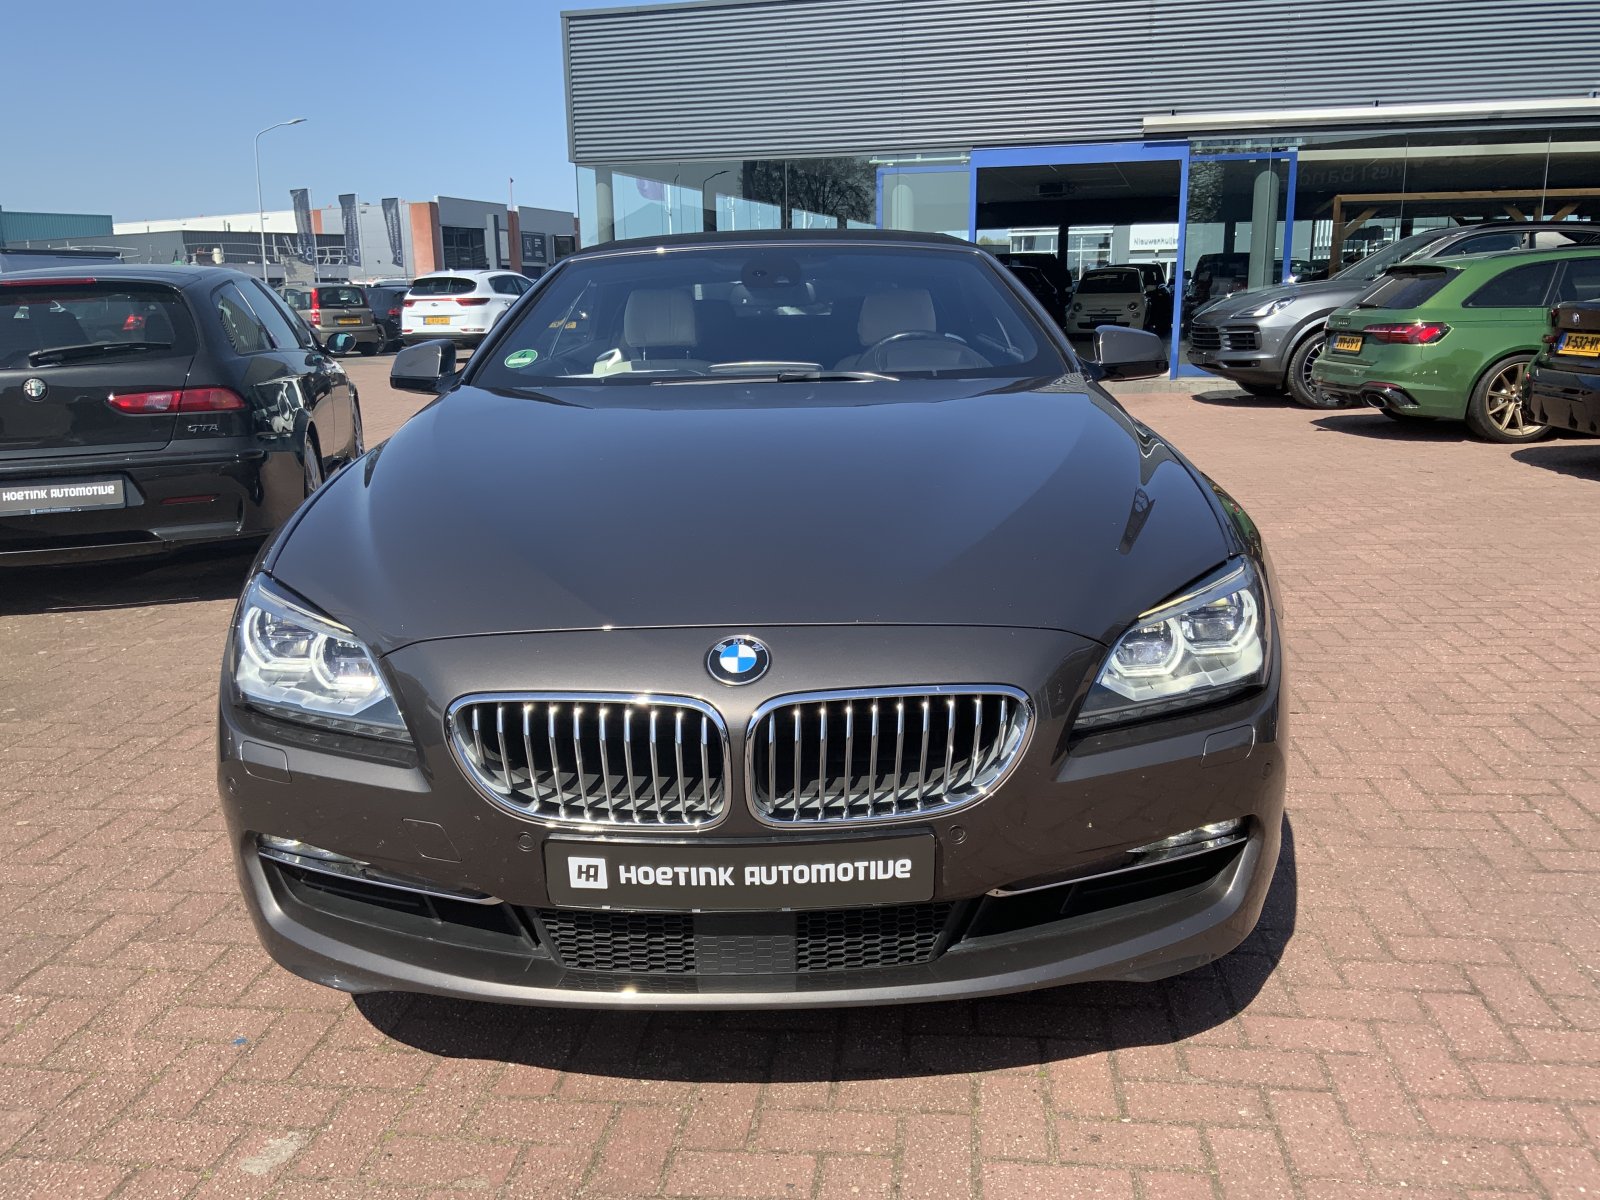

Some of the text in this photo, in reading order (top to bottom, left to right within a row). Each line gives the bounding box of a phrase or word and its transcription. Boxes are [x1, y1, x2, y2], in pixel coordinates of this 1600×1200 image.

[50, 485, 115, 499] AUTOMOTIVE
[714, 638, 765, 653] BMW
[744, 858, 913, 887] AUTOMOTIVE
